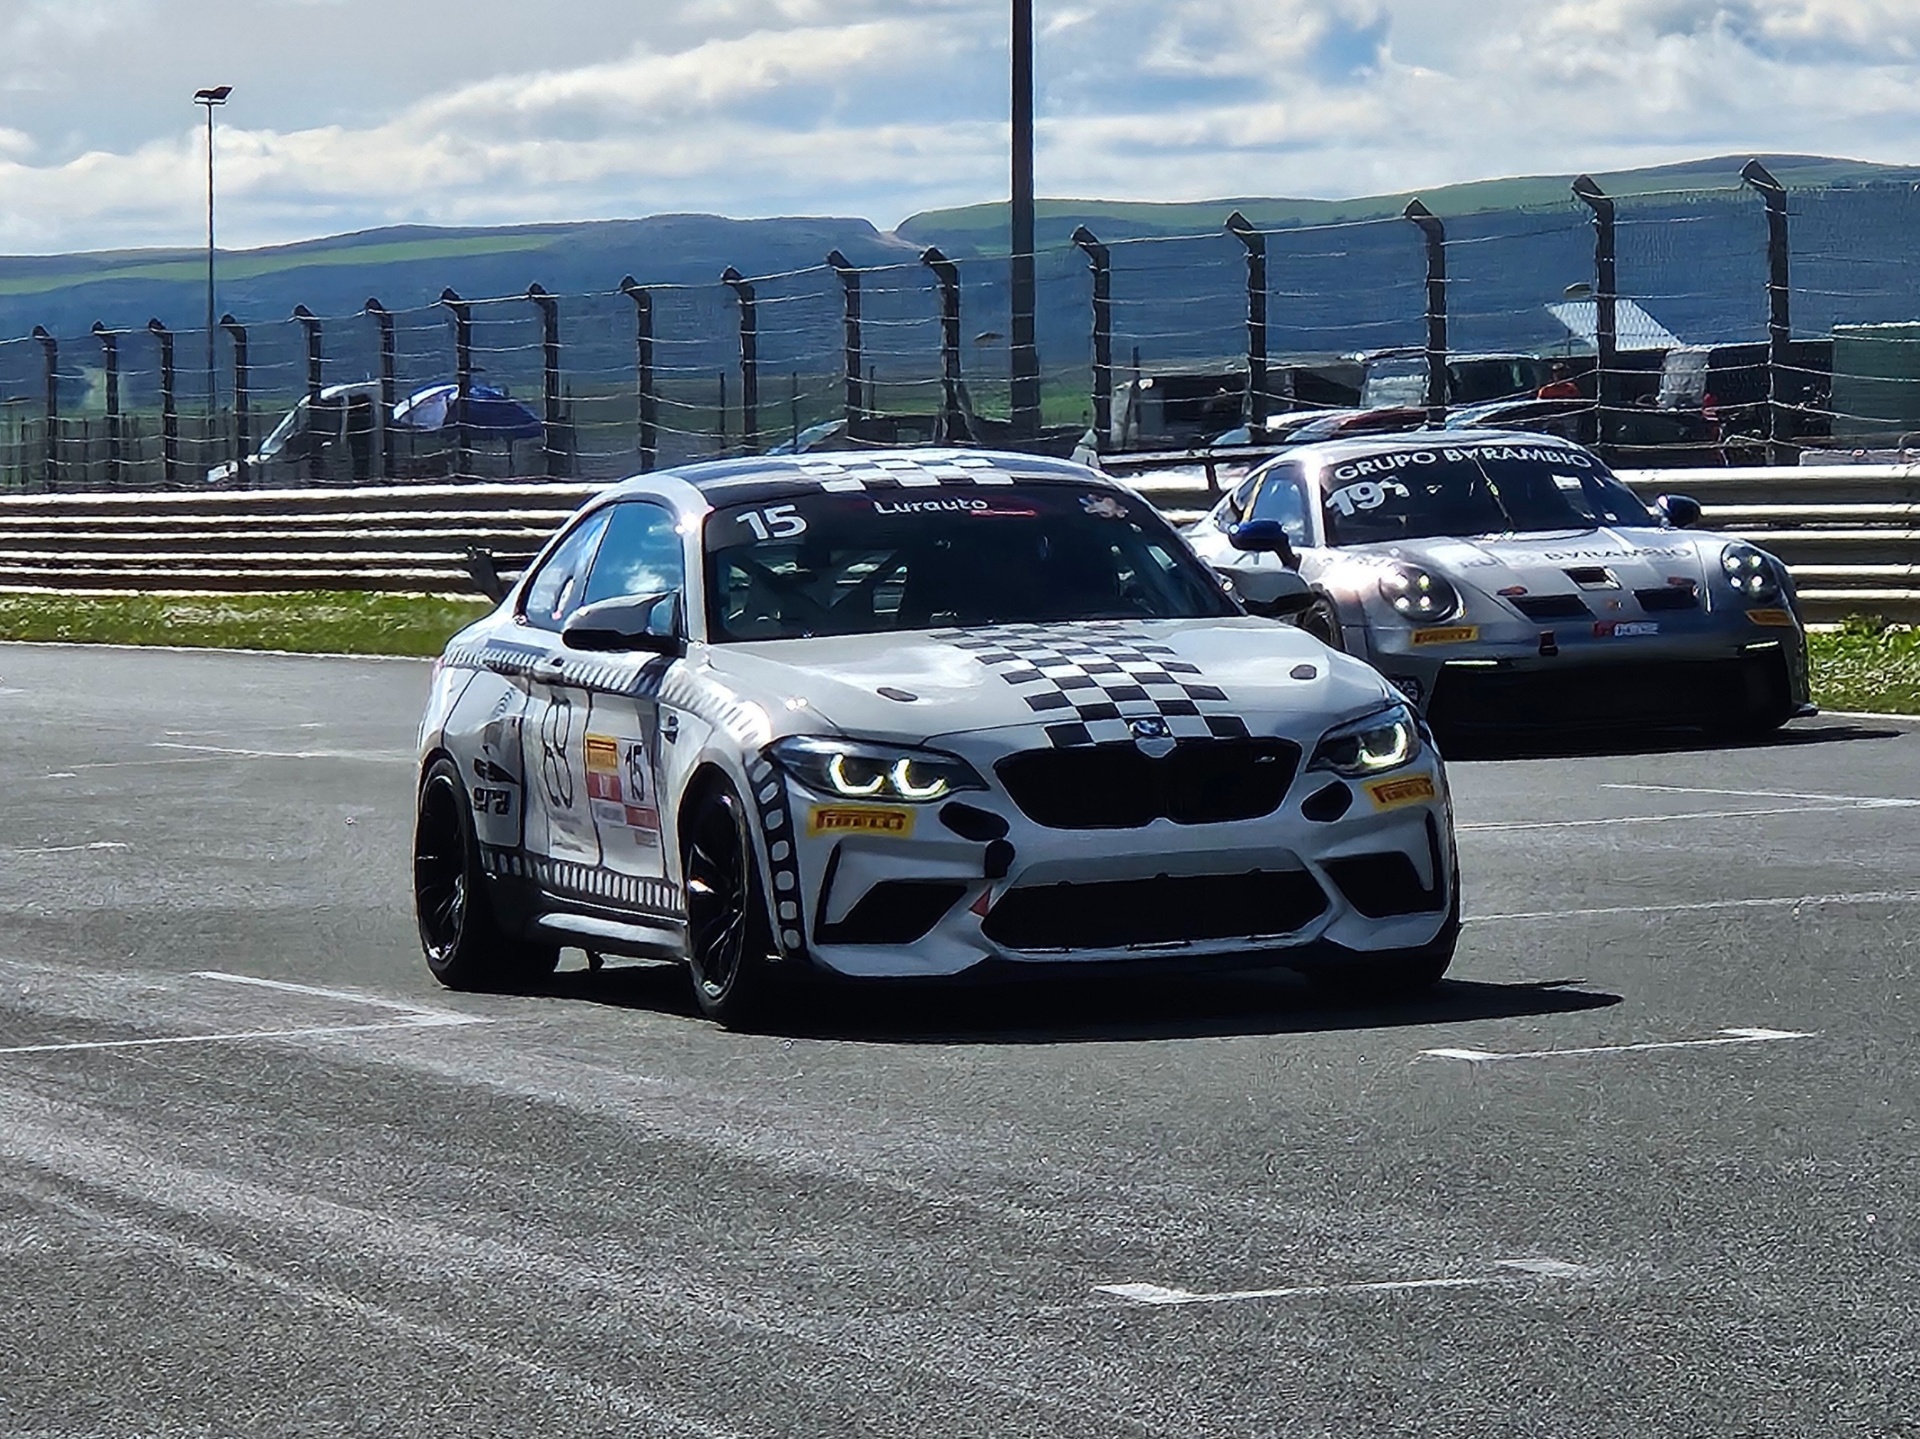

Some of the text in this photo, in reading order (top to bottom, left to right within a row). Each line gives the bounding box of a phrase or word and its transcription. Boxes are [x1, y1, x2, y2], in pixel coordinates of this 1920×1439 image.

[1334, 447, 1592, 480] GRUPO BYRAMBIO
[736, 504, 807, 540] 15
[873, 498, 989, 514] Lurauto
